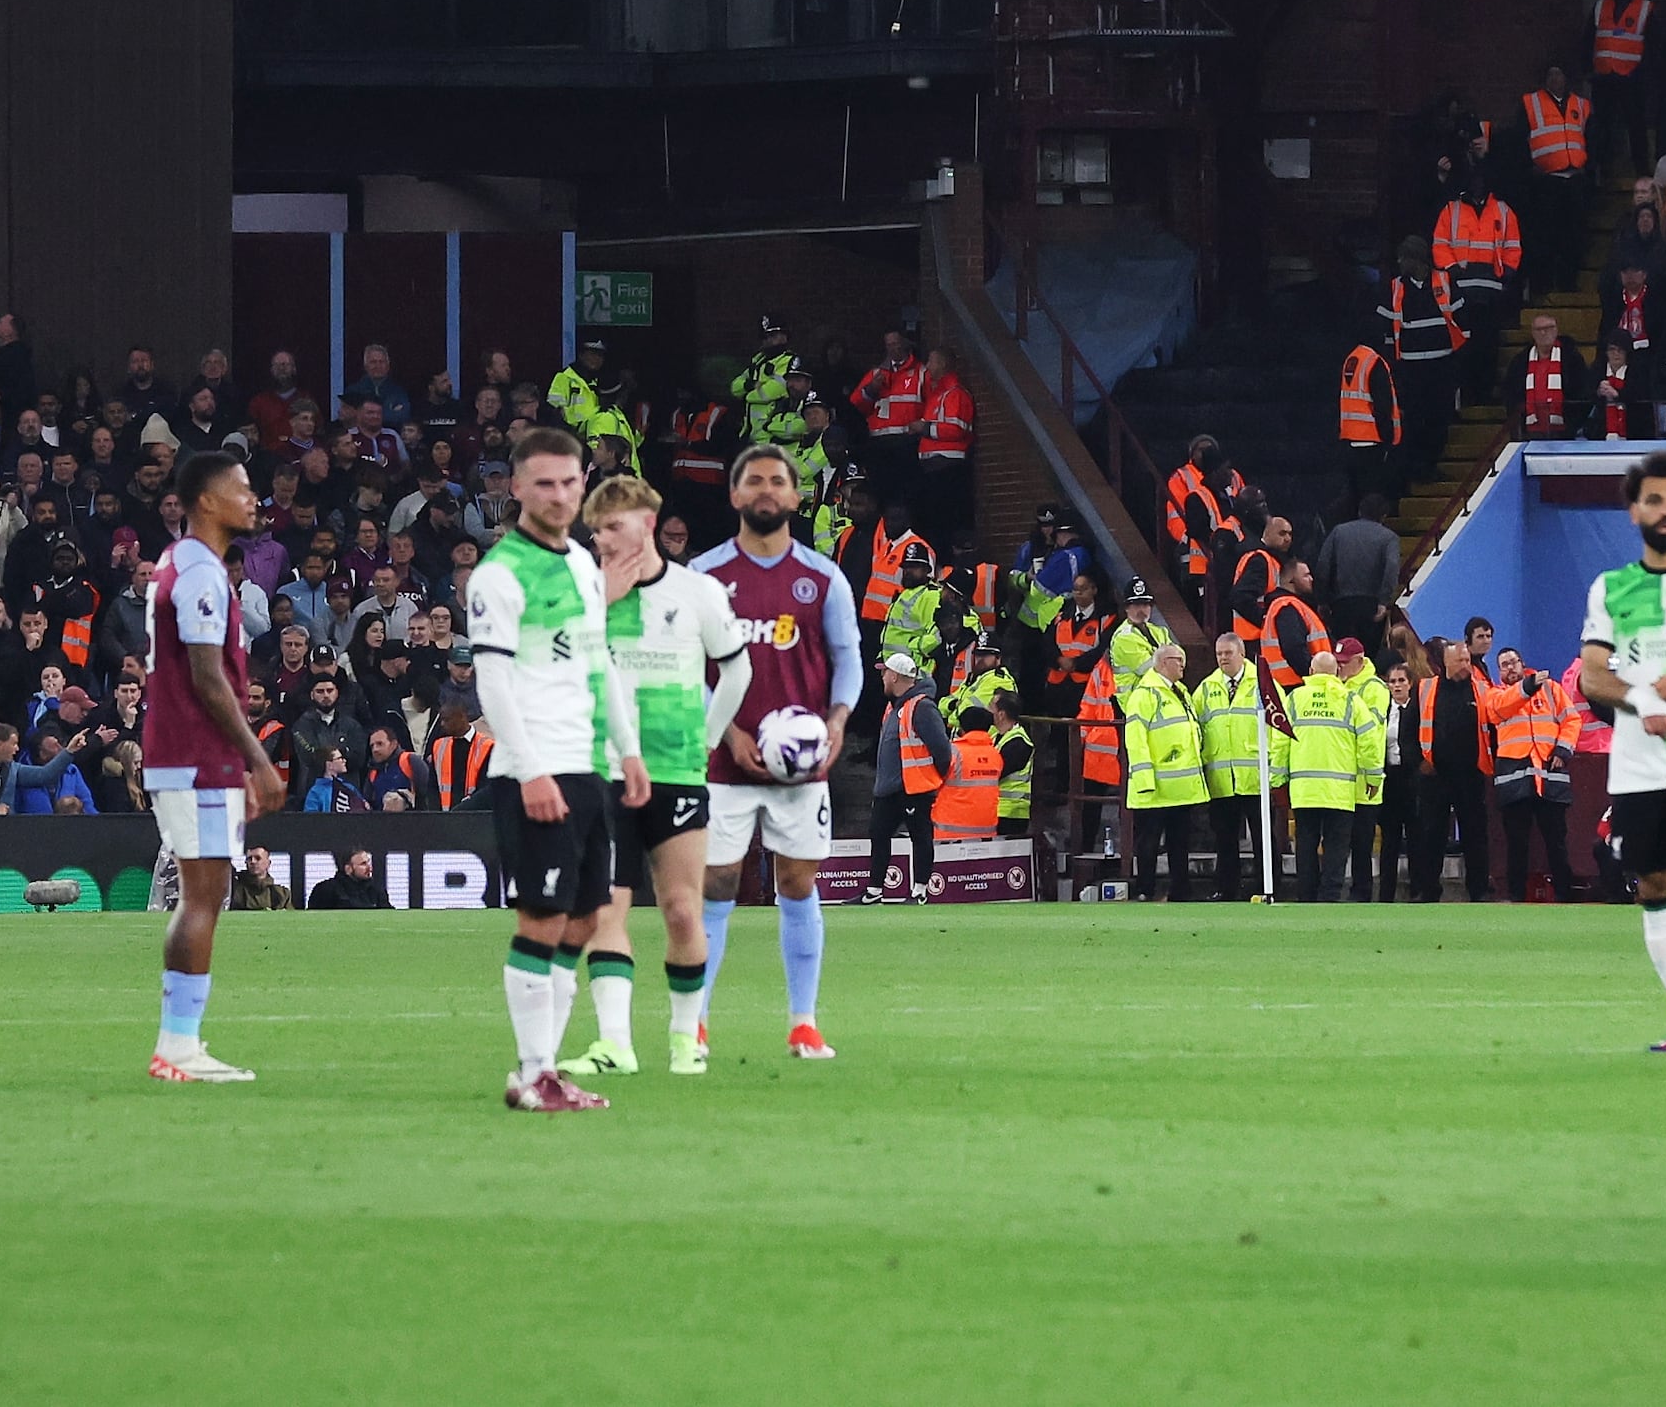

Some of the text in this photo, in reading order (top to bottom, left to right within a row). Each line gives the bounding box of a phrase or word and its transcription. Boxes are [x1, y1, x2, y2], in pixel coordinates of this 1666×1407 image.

[617, 283, 649, 297] Fire
[617, 301, 646, 315] exit
[817, 794, 829, 826] 6
[958, 872, 1004, 882] UNAUTHORISED
[830, 880, 859, 888] ACCESS
[964, 882, 988, 890] ACCESS
